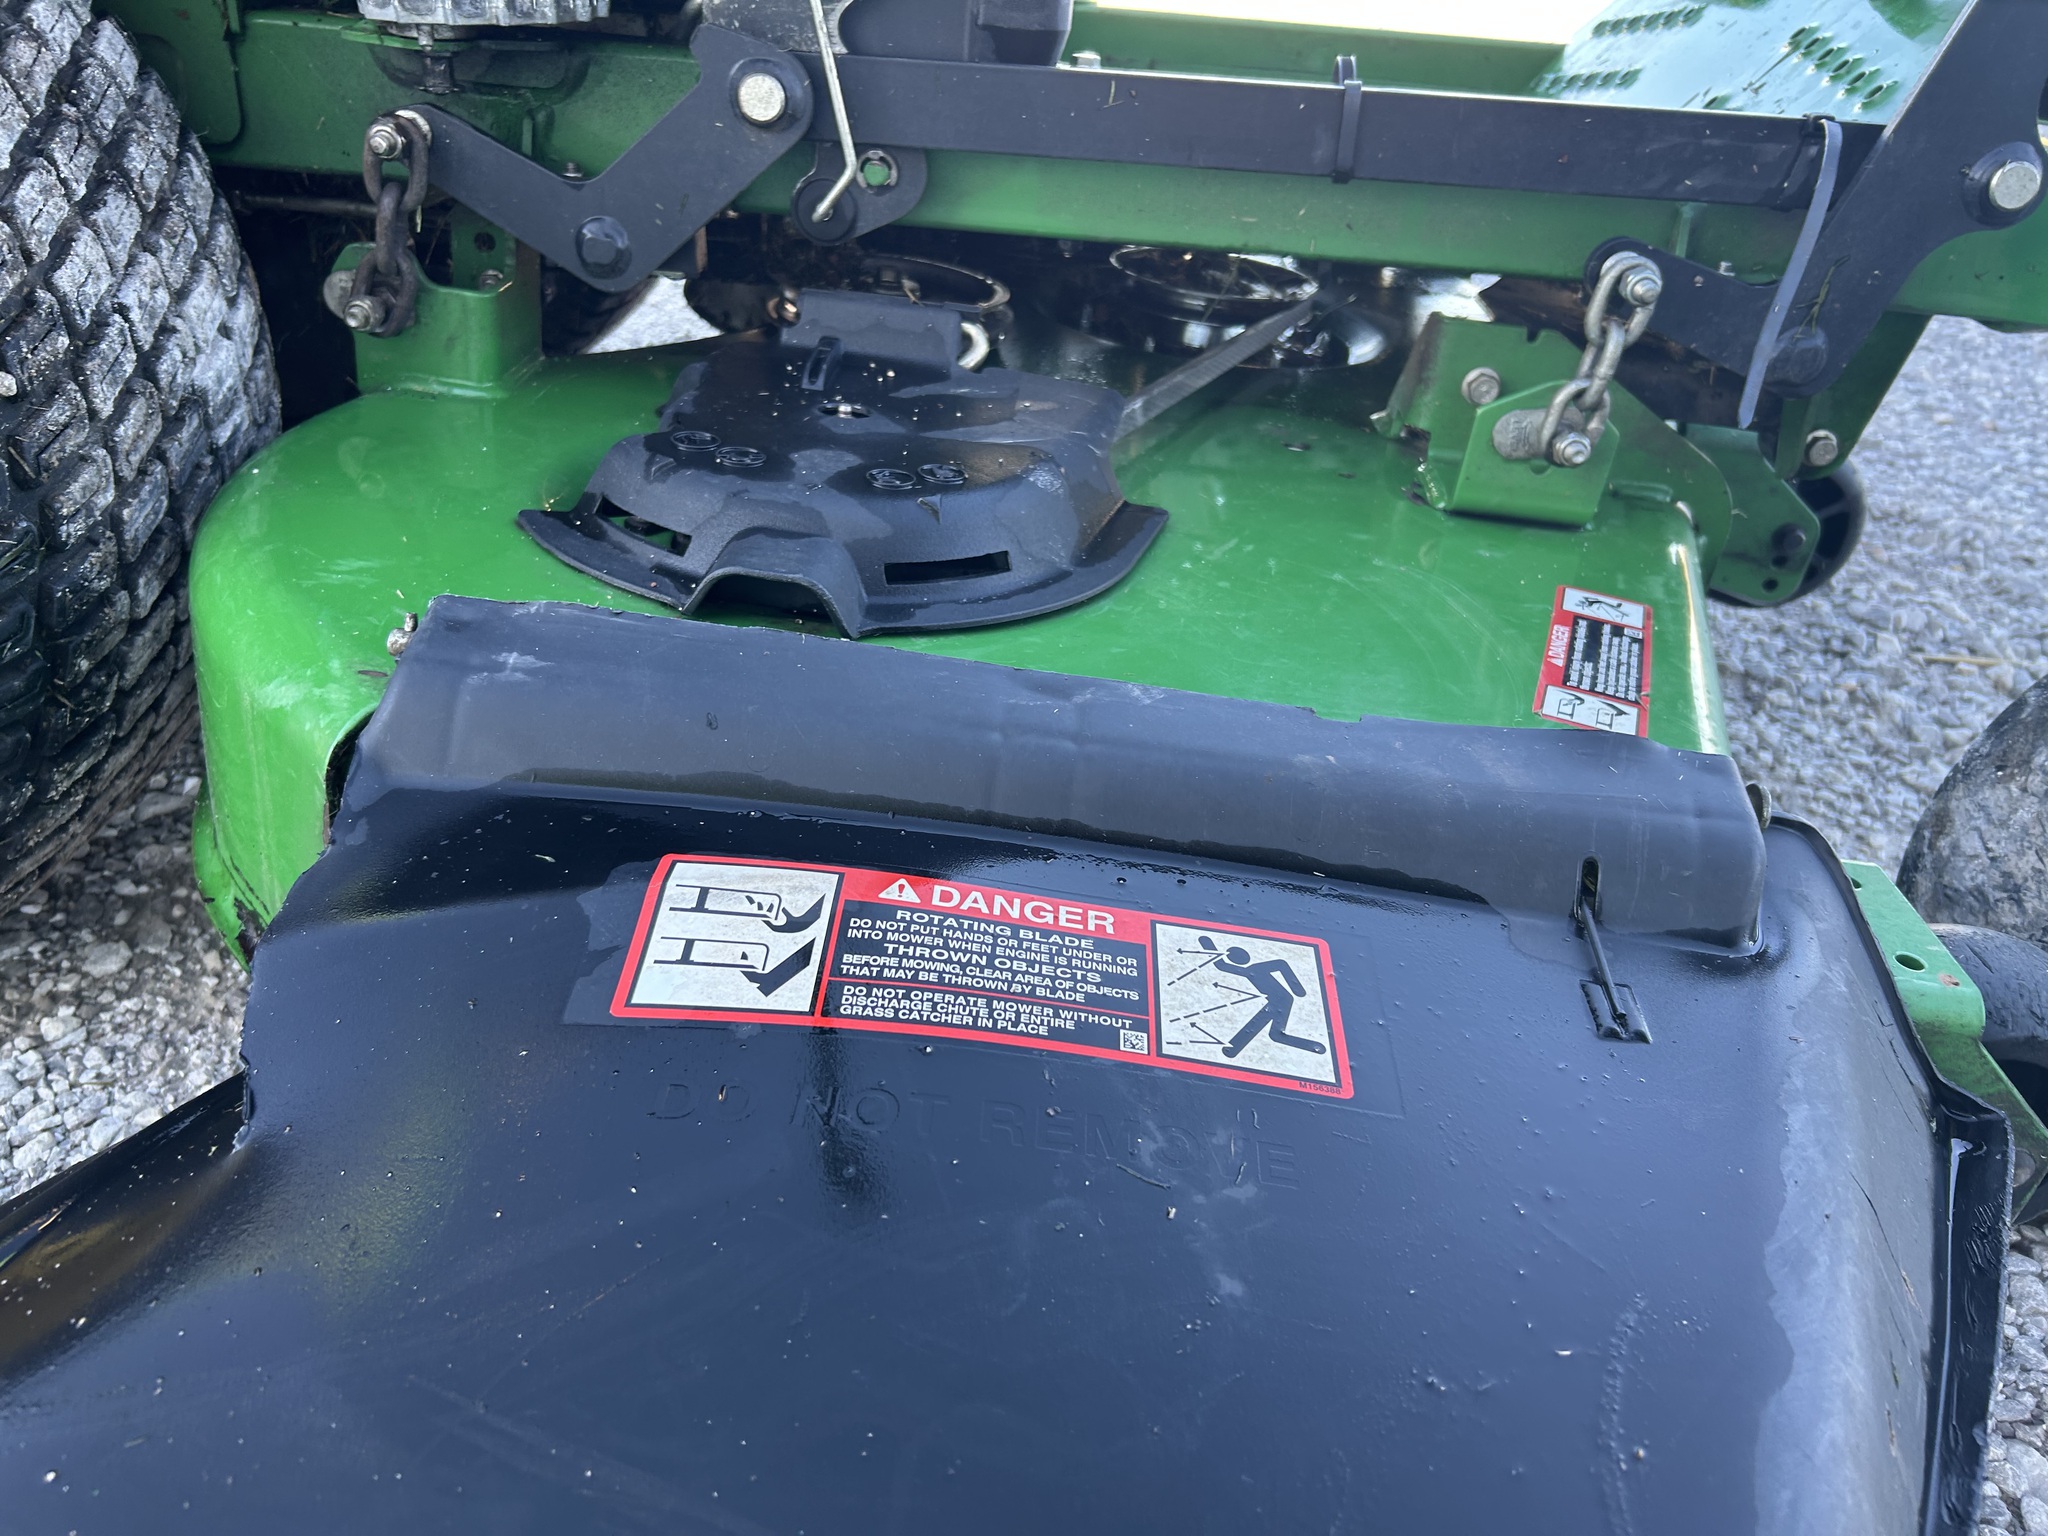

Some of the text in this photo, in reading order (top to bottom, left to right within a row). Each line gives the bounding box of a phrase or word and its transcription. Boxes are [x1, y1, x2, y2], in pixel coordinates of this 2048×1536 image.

[1547, 624, 1570, 658] DANGER
[896, 910, 1094, 949] ROTATING BLADE
[932, 885, 1115, 934] DANGER
[848, 929, 1138, 976] INTO MOWER WHEN ENGINE IS RUNNING
[850, 918, 1137, 966] DO NOT PUT HANDS OR FEET UNDER OR
[884, 943, 1101, 982] THROWN OBJECTS
[841, 965, 1085, 1002] THAT MAY BE THROWN BY BLADE
[843, 954, 1139, 1000] BEFORE MOWING, CLEAR AREA OF OBJECTS
[840, 1005, 1048, 1035] GRASS CATCHER IN PLACE
[842, 996, 1075, 1029] DISCHARGE CHUTE OR ENTIRE
[843, 986, 1132, 1029] DO NOT OPERATE MOWER WITHOUT
[646, 1083, 1299, 1190] DO NOT REMOVE
